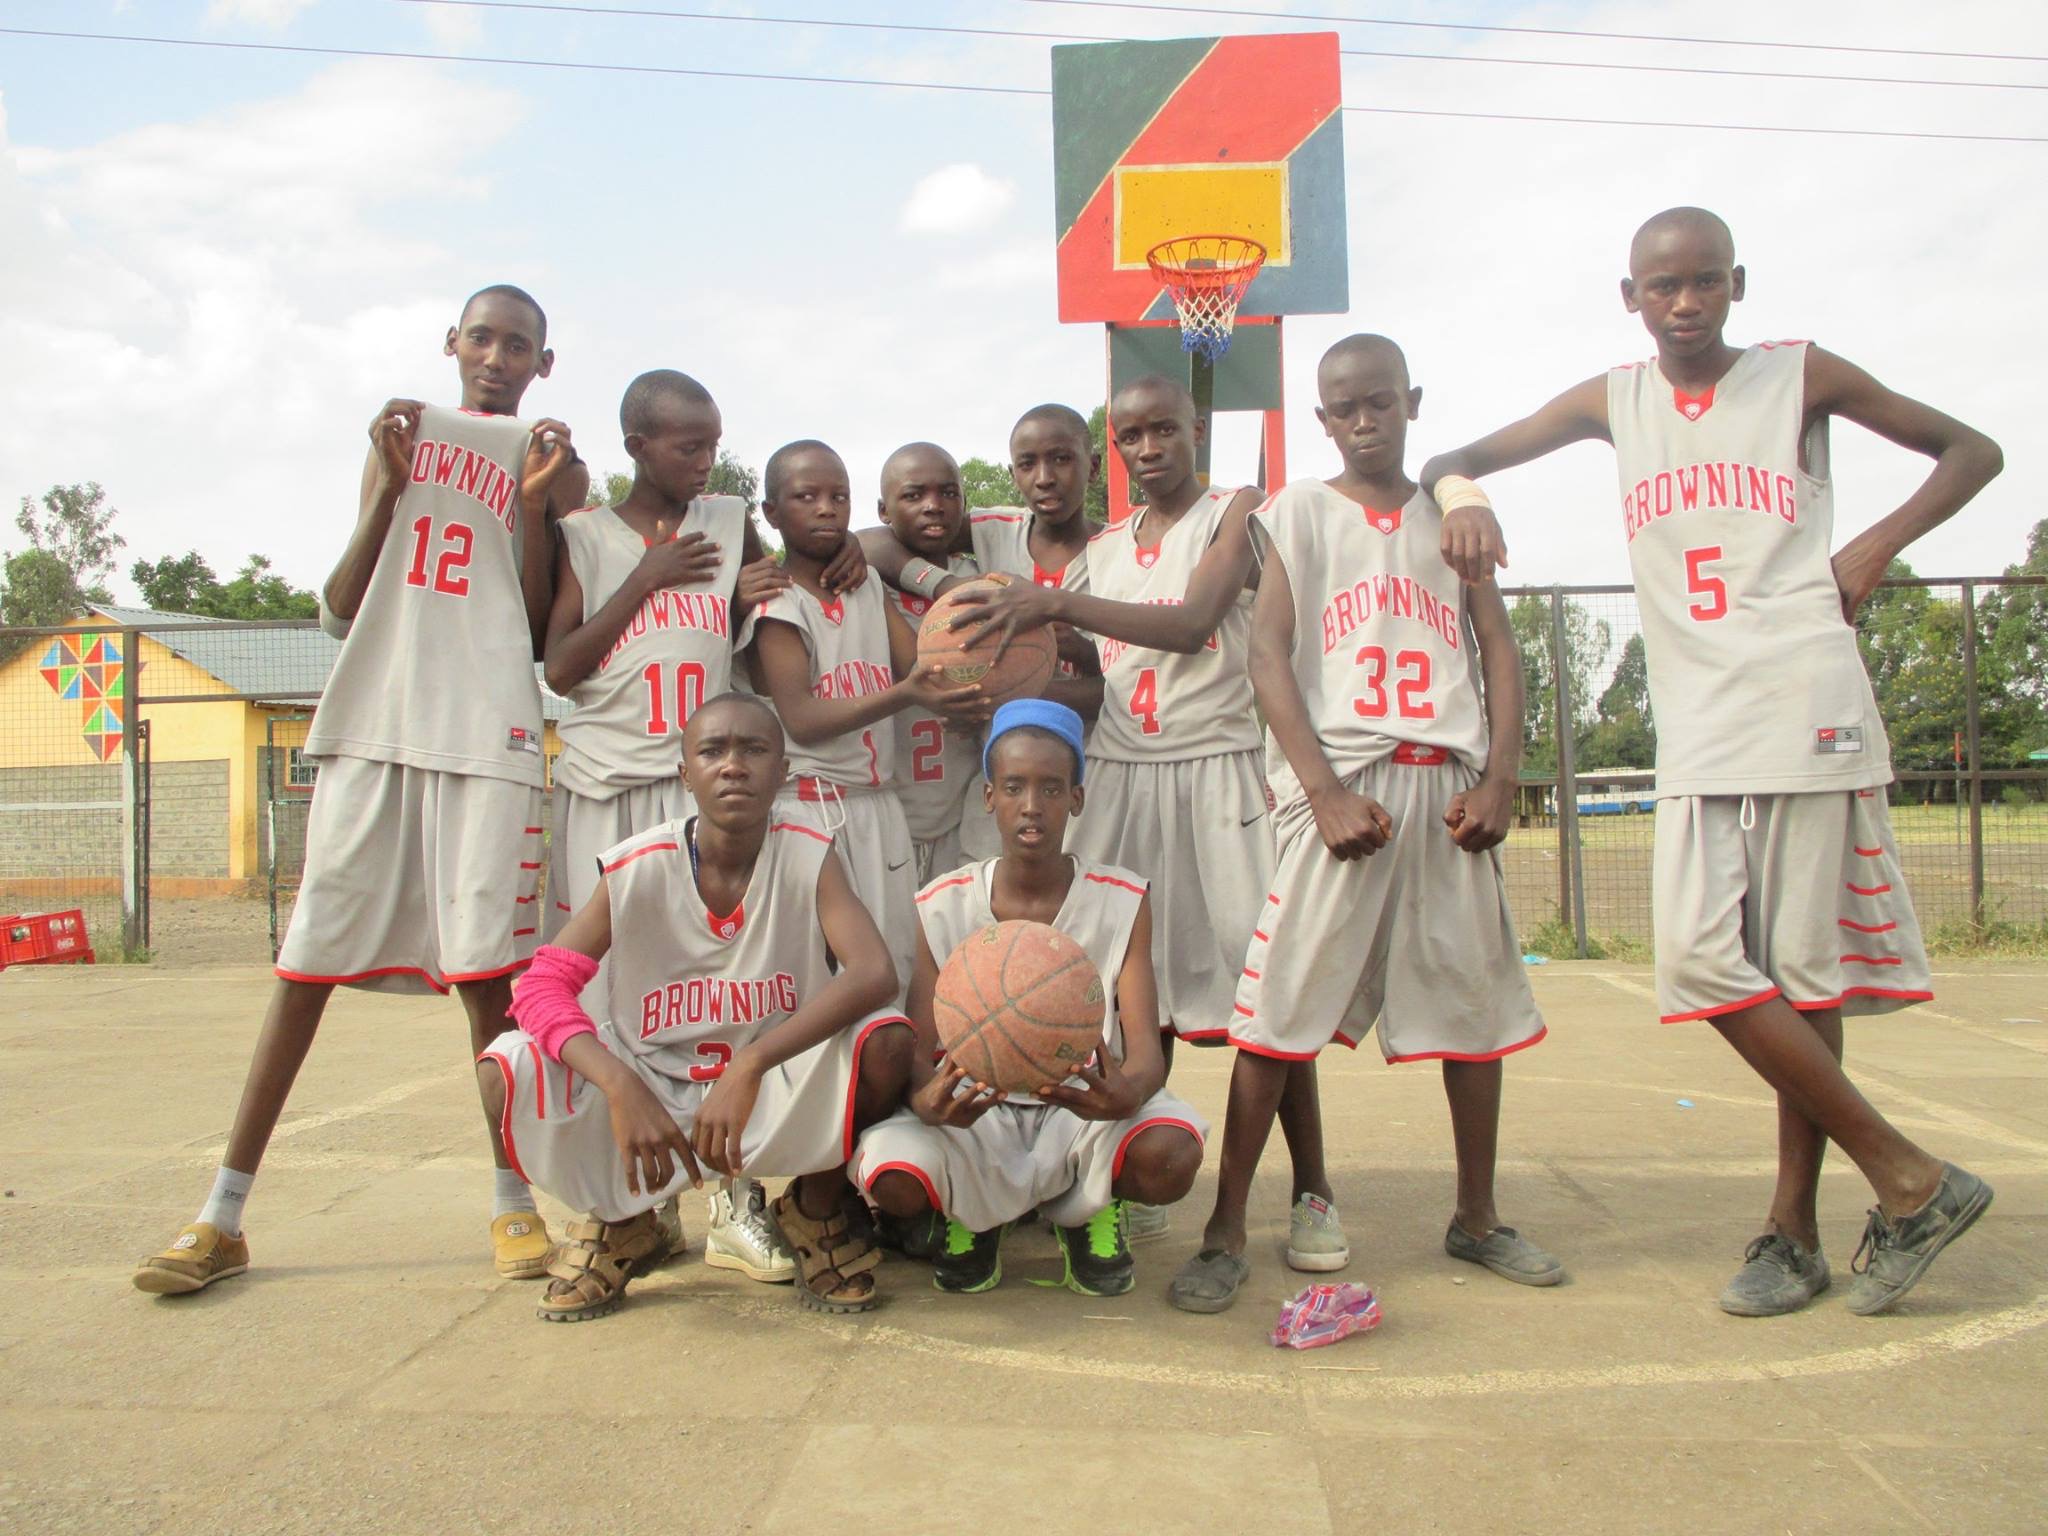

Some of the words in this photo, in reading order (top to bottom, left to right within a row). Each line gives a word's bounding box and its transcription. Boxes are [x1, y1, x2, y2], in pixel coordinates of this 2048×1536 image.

[1623, 460, 1797, 545] BROWNING
[405, 514, 474, 598] 12
[1683, 544, 1728, 622] 5
[1322, 571, 1459, 656] BROWNING
[642, 661, 706, 736] 10
[1128, 666, 1161, 736] 4
[1353, 645, 1438, 721] 32
[911, 719, 944, 783] 2
[639, 970, 800, 1041] BROWNING
[688, 1040, 733, 1083] 3
